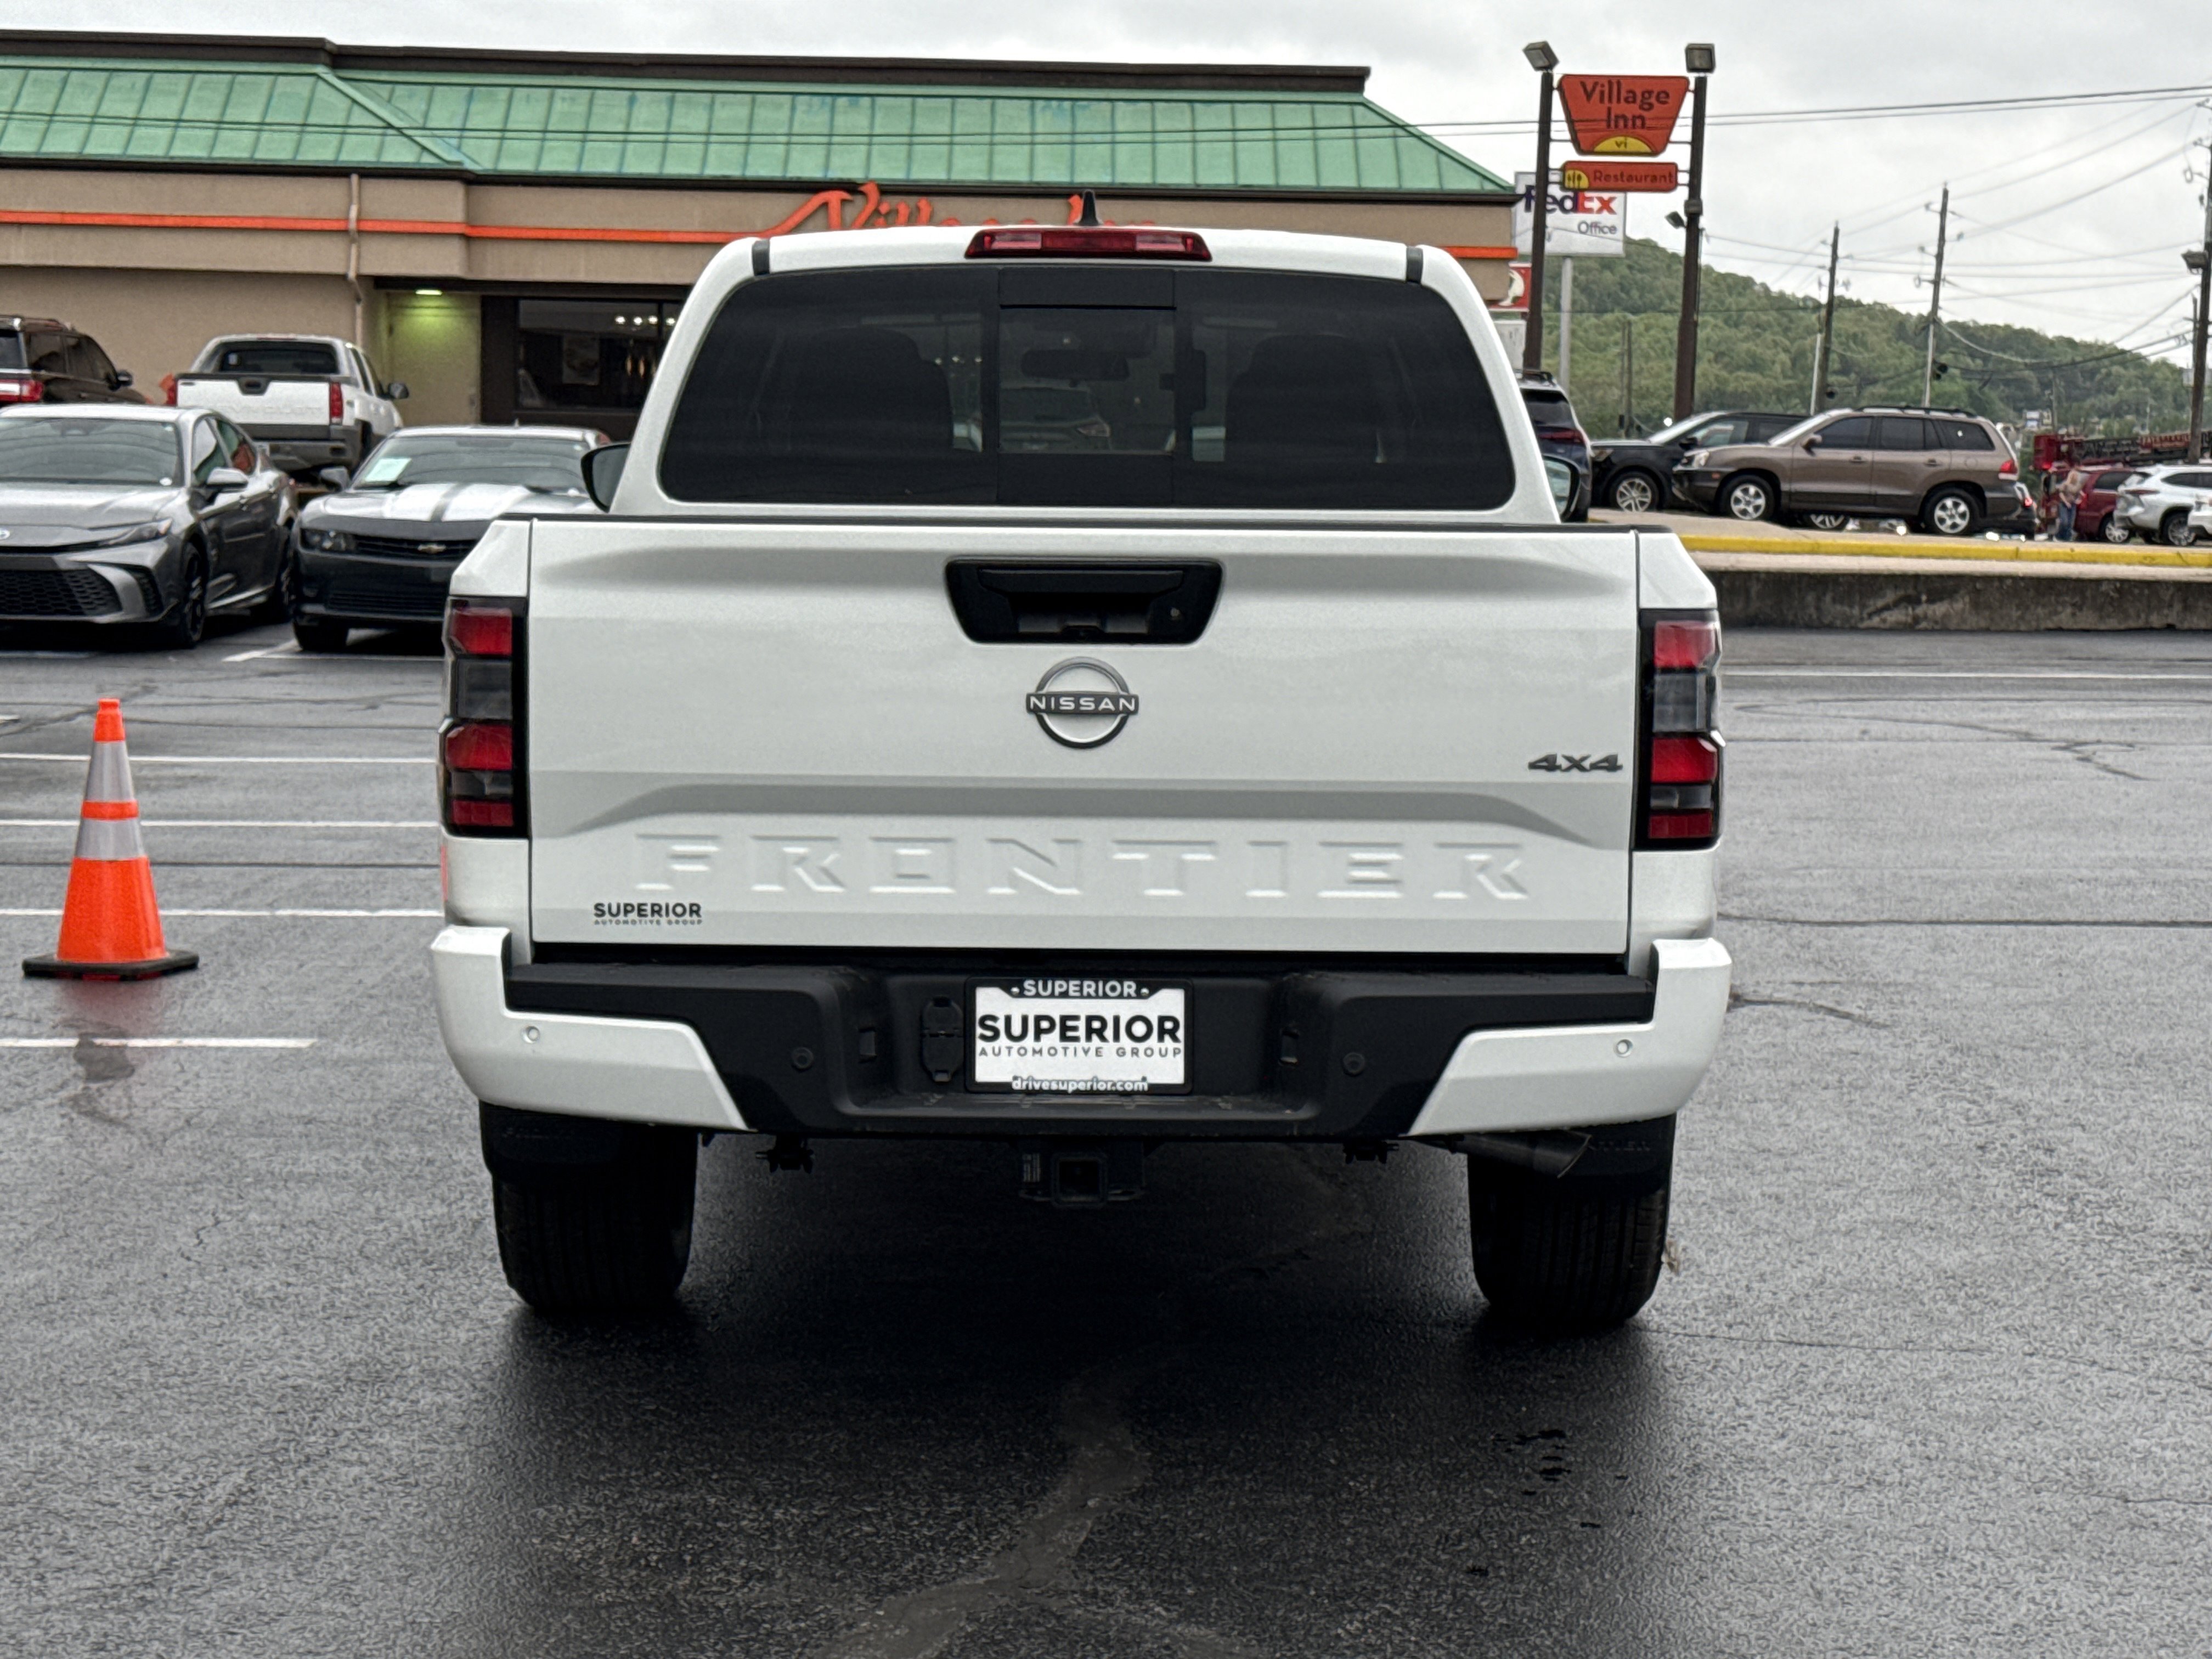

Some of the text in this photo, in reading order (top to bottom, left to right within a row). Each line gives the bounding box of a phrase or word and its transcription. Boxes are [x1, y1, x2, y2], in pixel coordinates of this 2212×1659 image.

[1580, 80, 1670, 111] Village
[1606, 106, 1646, 129] Inn
[1593, 170, 1674, 184] Restaurant
[1578, 221, 1617, 235] Office
[1030, 696, 1135, 712] NISSAN
[635, 834, 1528, 900] FRONTIER
[594, 902, 702, 918] SUPERIOR
[1023, 980, 1137, 997] SUPERIOR
[978, 1014, 1182, 1043] SUPERIOR
[979, 1046, 1182, 1058] AUTOMOTIVE GROUP
[1012, 1076, 1149, 1093] drivesuperior.com
